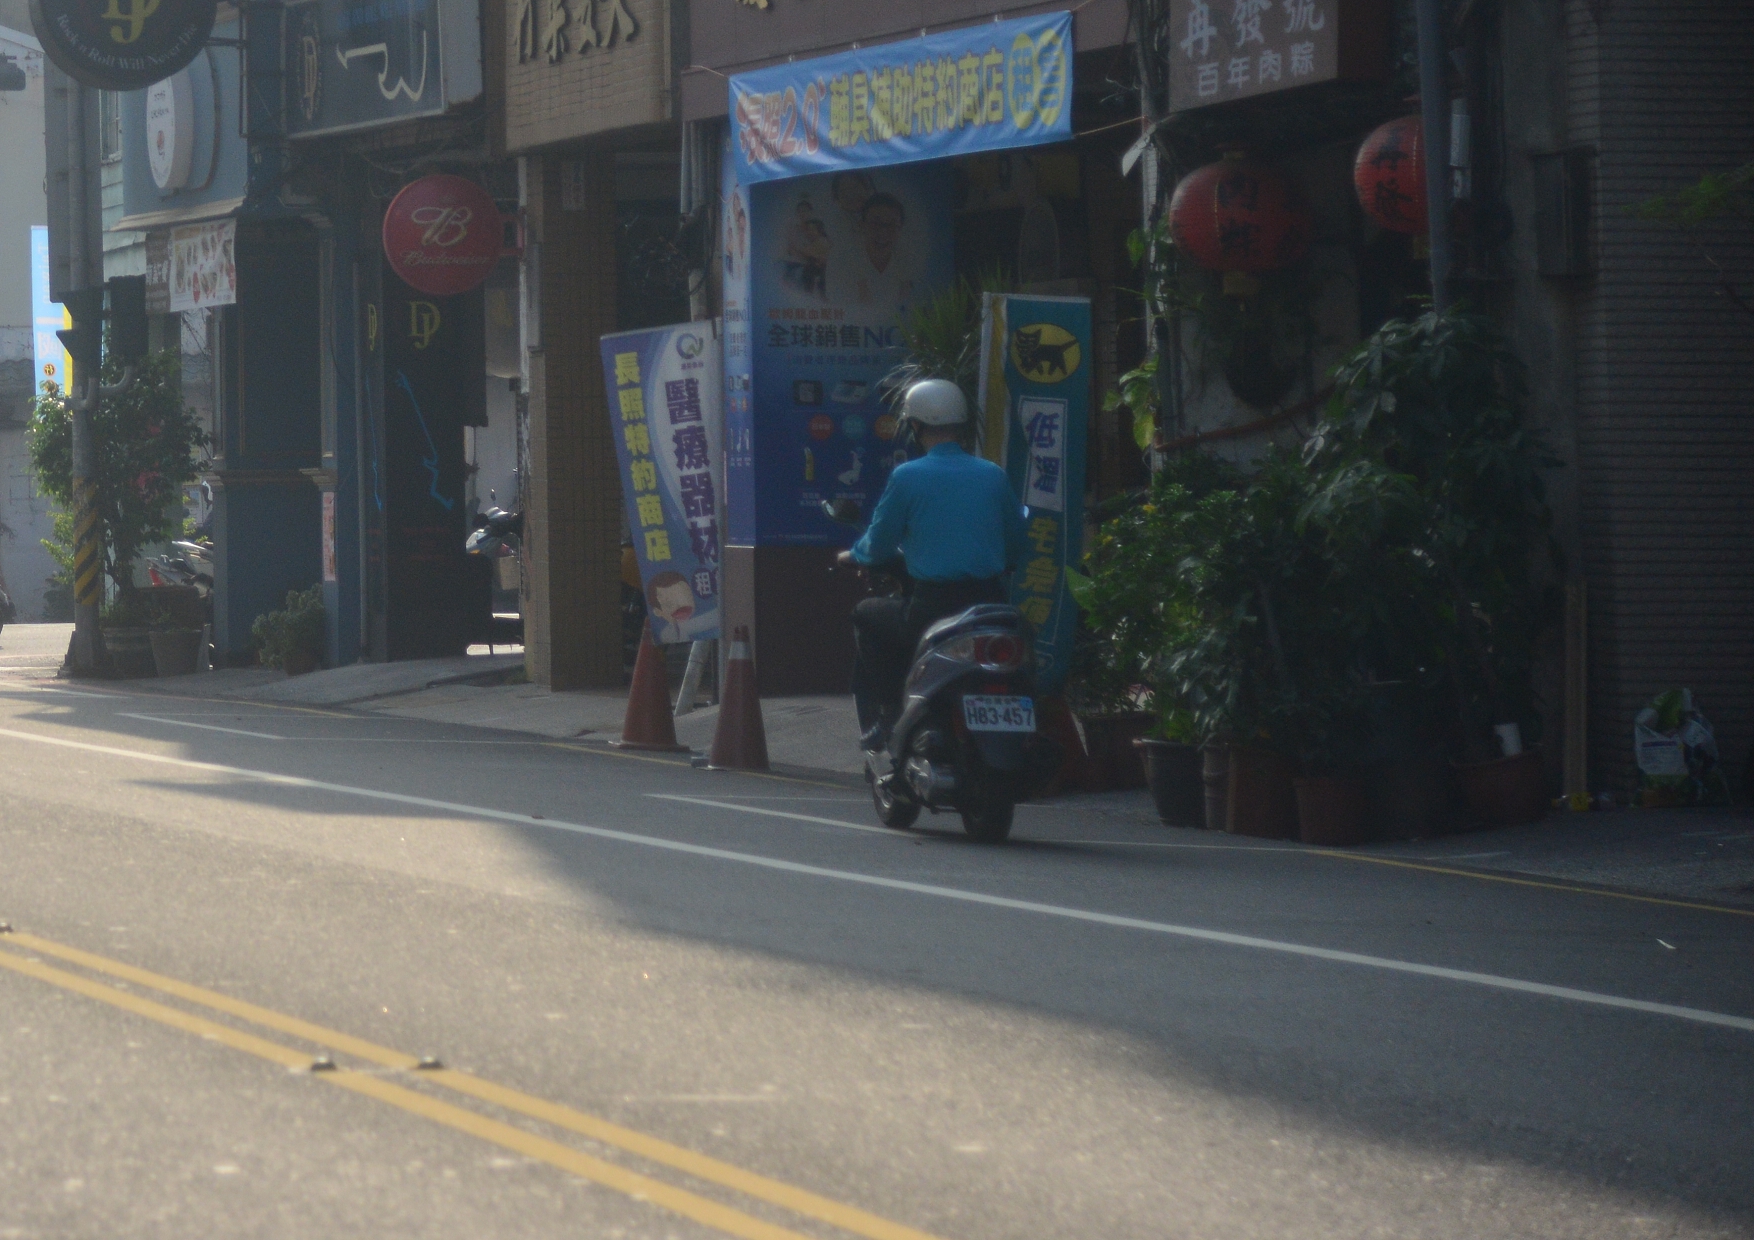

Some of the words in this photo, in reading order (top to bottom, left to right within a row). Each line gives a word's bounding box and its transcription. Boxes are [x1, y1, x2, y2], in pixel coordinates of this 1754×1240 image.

[1196, 40, 1315, 97] 百年肉粽
[615, 352, 671, 562] 長照特約商店
[665, 378, 718, 563] 醫療器材
